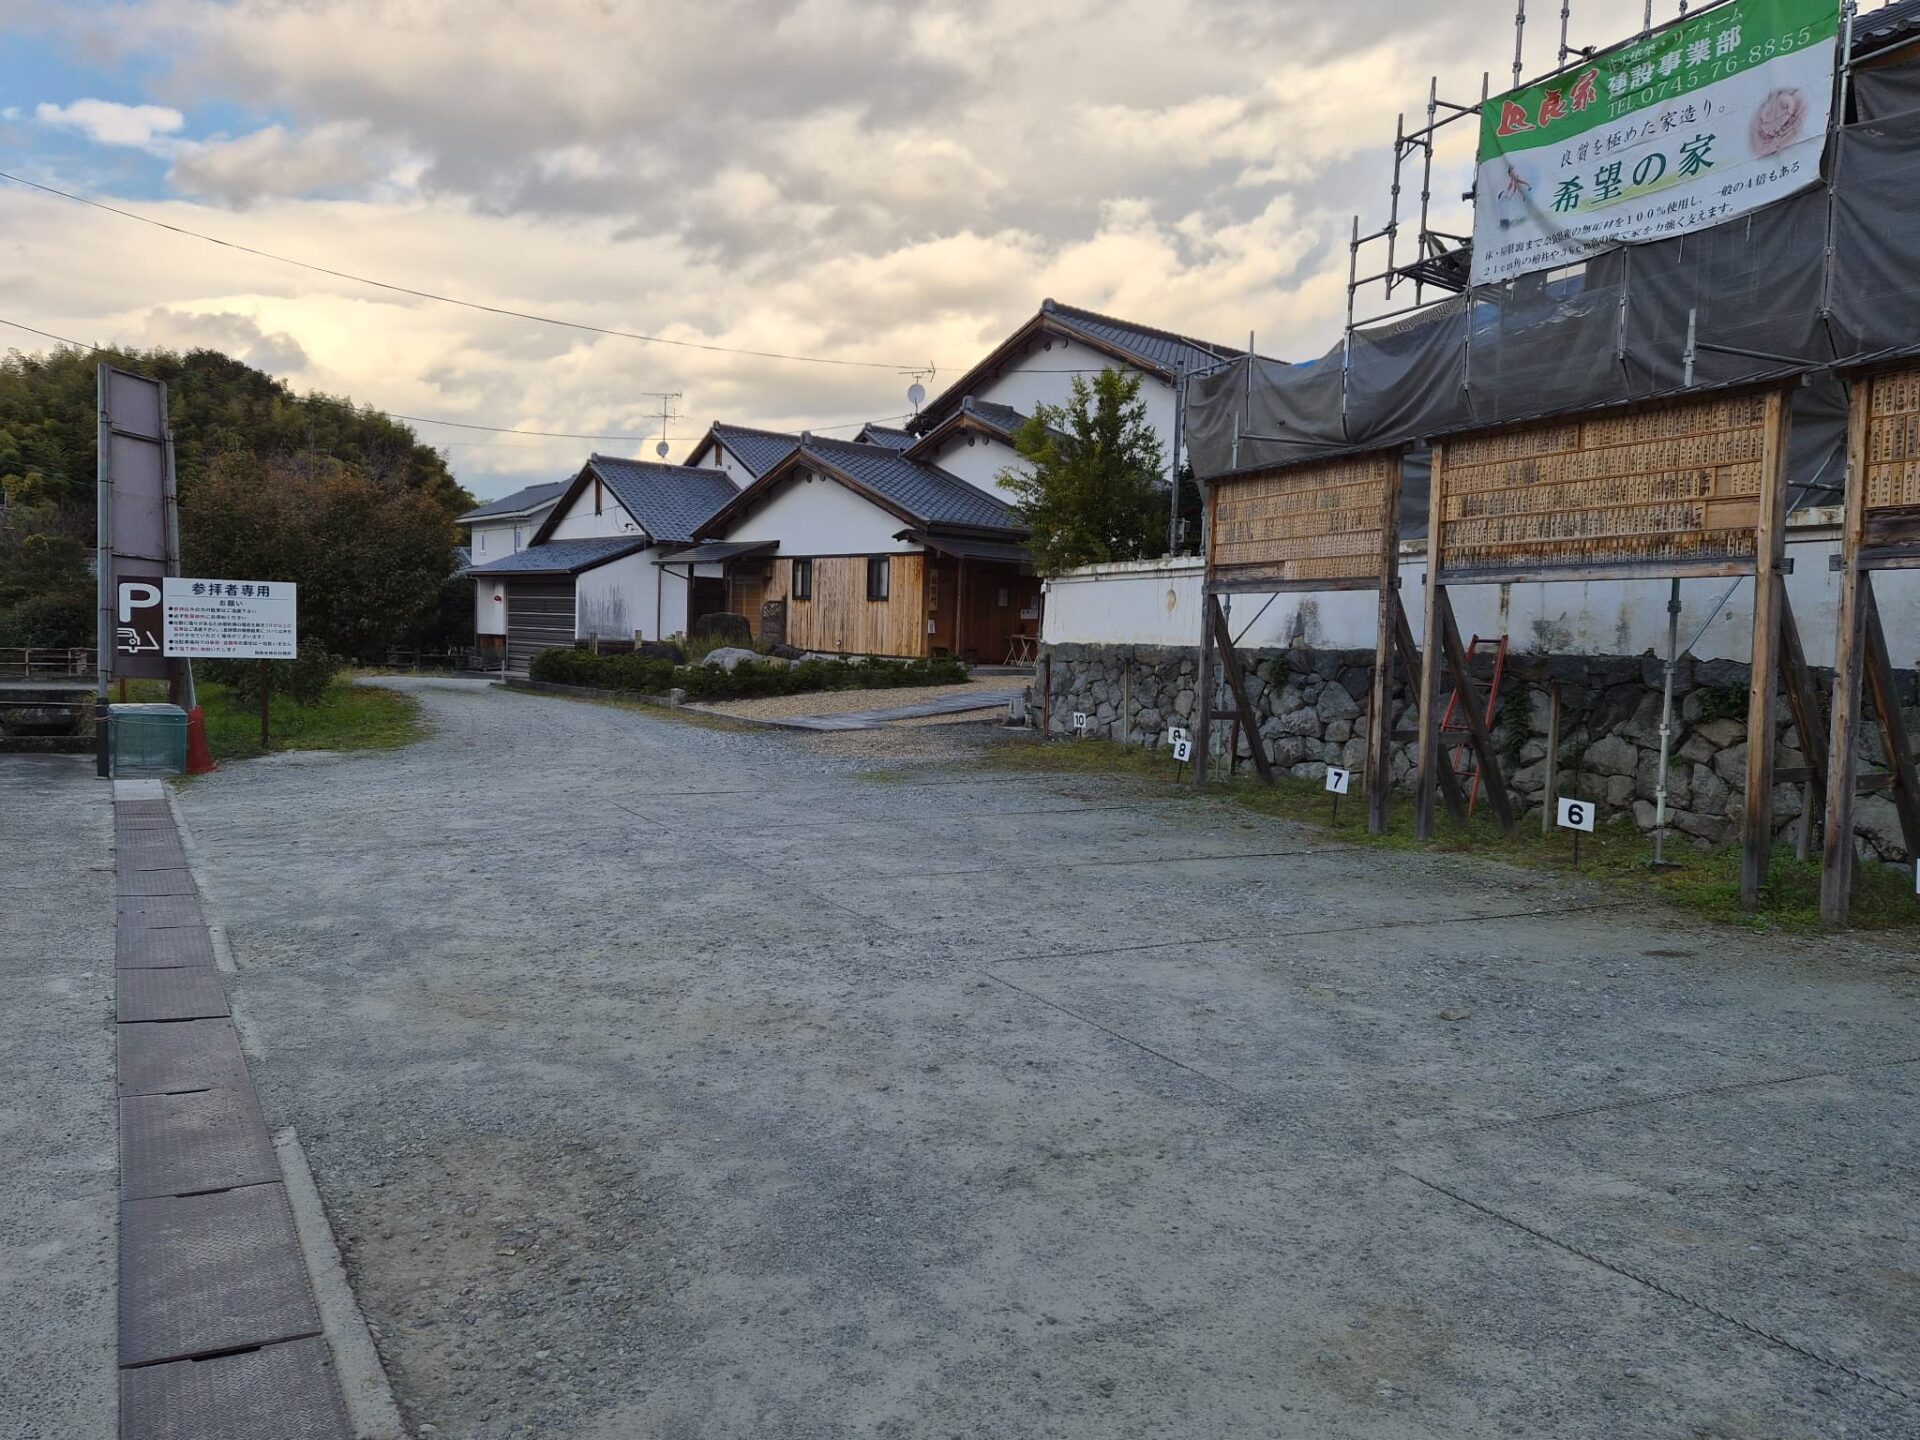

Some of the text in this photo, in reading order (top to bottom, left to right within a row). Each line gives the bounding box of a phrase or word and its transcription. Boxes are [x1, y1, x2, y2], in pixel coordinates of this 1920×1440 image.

[1607, 25, 1742, 100] 建設事業部
[1607, 26, 1812, 118] TEL 0745-76-8855
[1560, 97, 1726, 168] 良質を極めた家造り。
[1549, 132, 1717, 213] 希望の家
[191, 581, 270, 598] 参拝者専用
[119, 582, 161, 622] P
[219, 599, 243, 607] お願い
[1074, 713, 1085, 727] 10
[1178, 743, 1187, 757] 8
[1332, 771, 1343, 790] 7
[1568, 804, 1584, 825] 6
